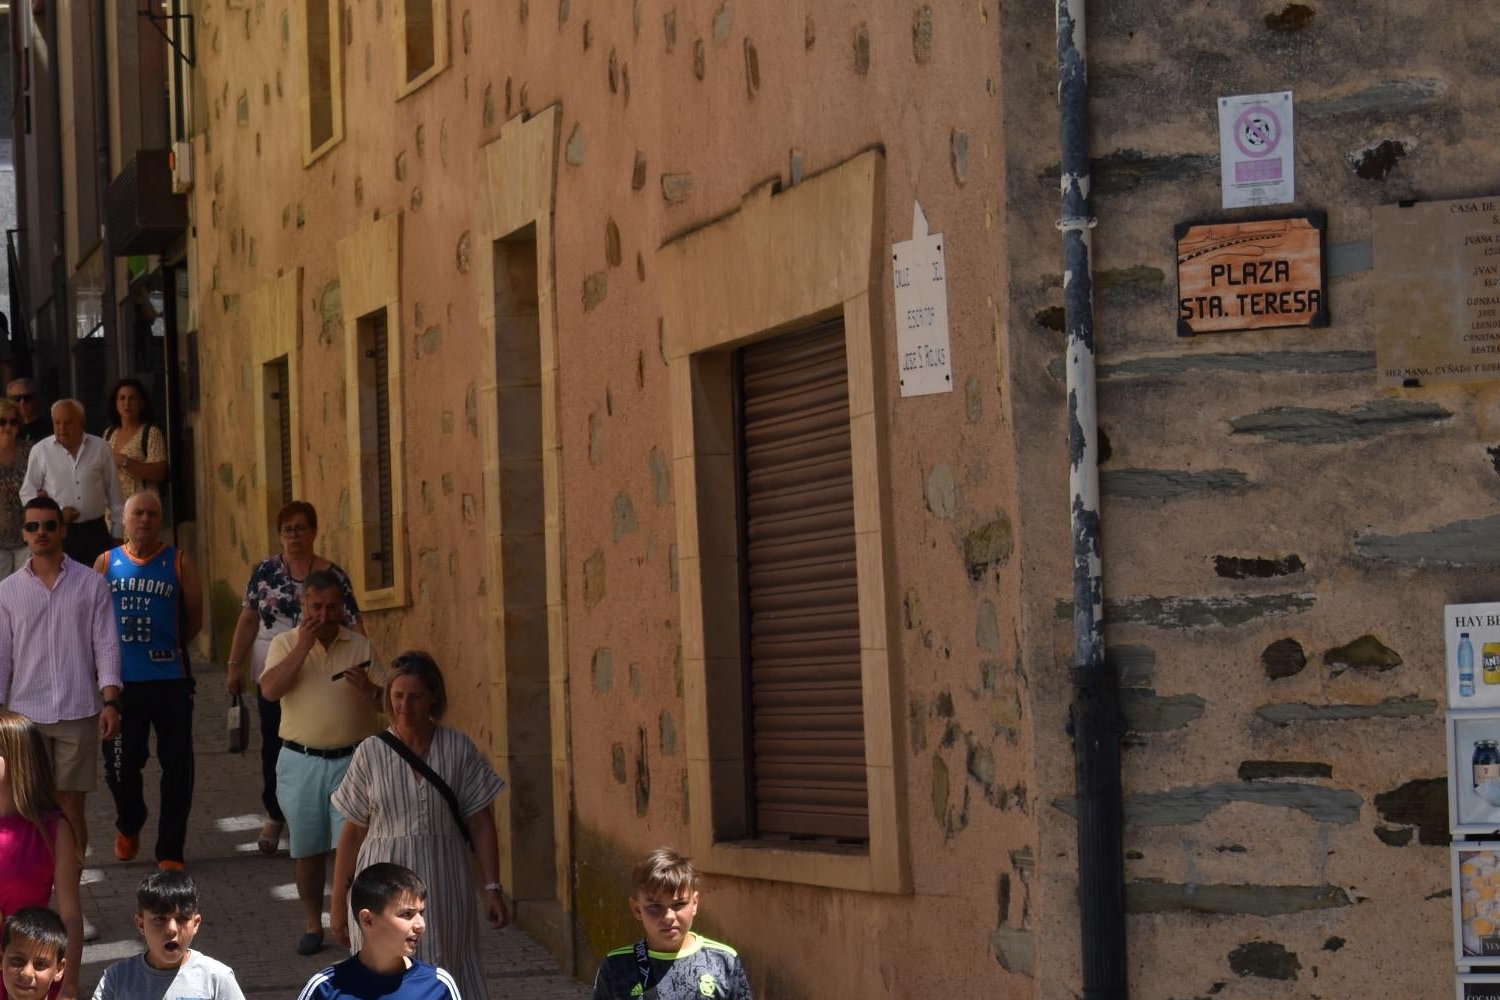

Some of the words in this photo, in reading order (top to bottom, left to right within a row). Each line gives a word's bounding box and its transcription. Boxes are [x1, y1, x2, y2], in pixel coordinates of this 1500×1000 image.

[1450, 202, 1478, 213] CASA
[1482, 201, 1496, 211] DE
[1210, 260, 1289, 287] PLAZA
[1180, 295, 1229, 320] STA.
[1236, 289, 1320, 316] TERESA
[108, 577, 173, 599] KLAHOMA
[121, 596, 151, 611] CITY
[1456, 616, 1483, 627] HAY
